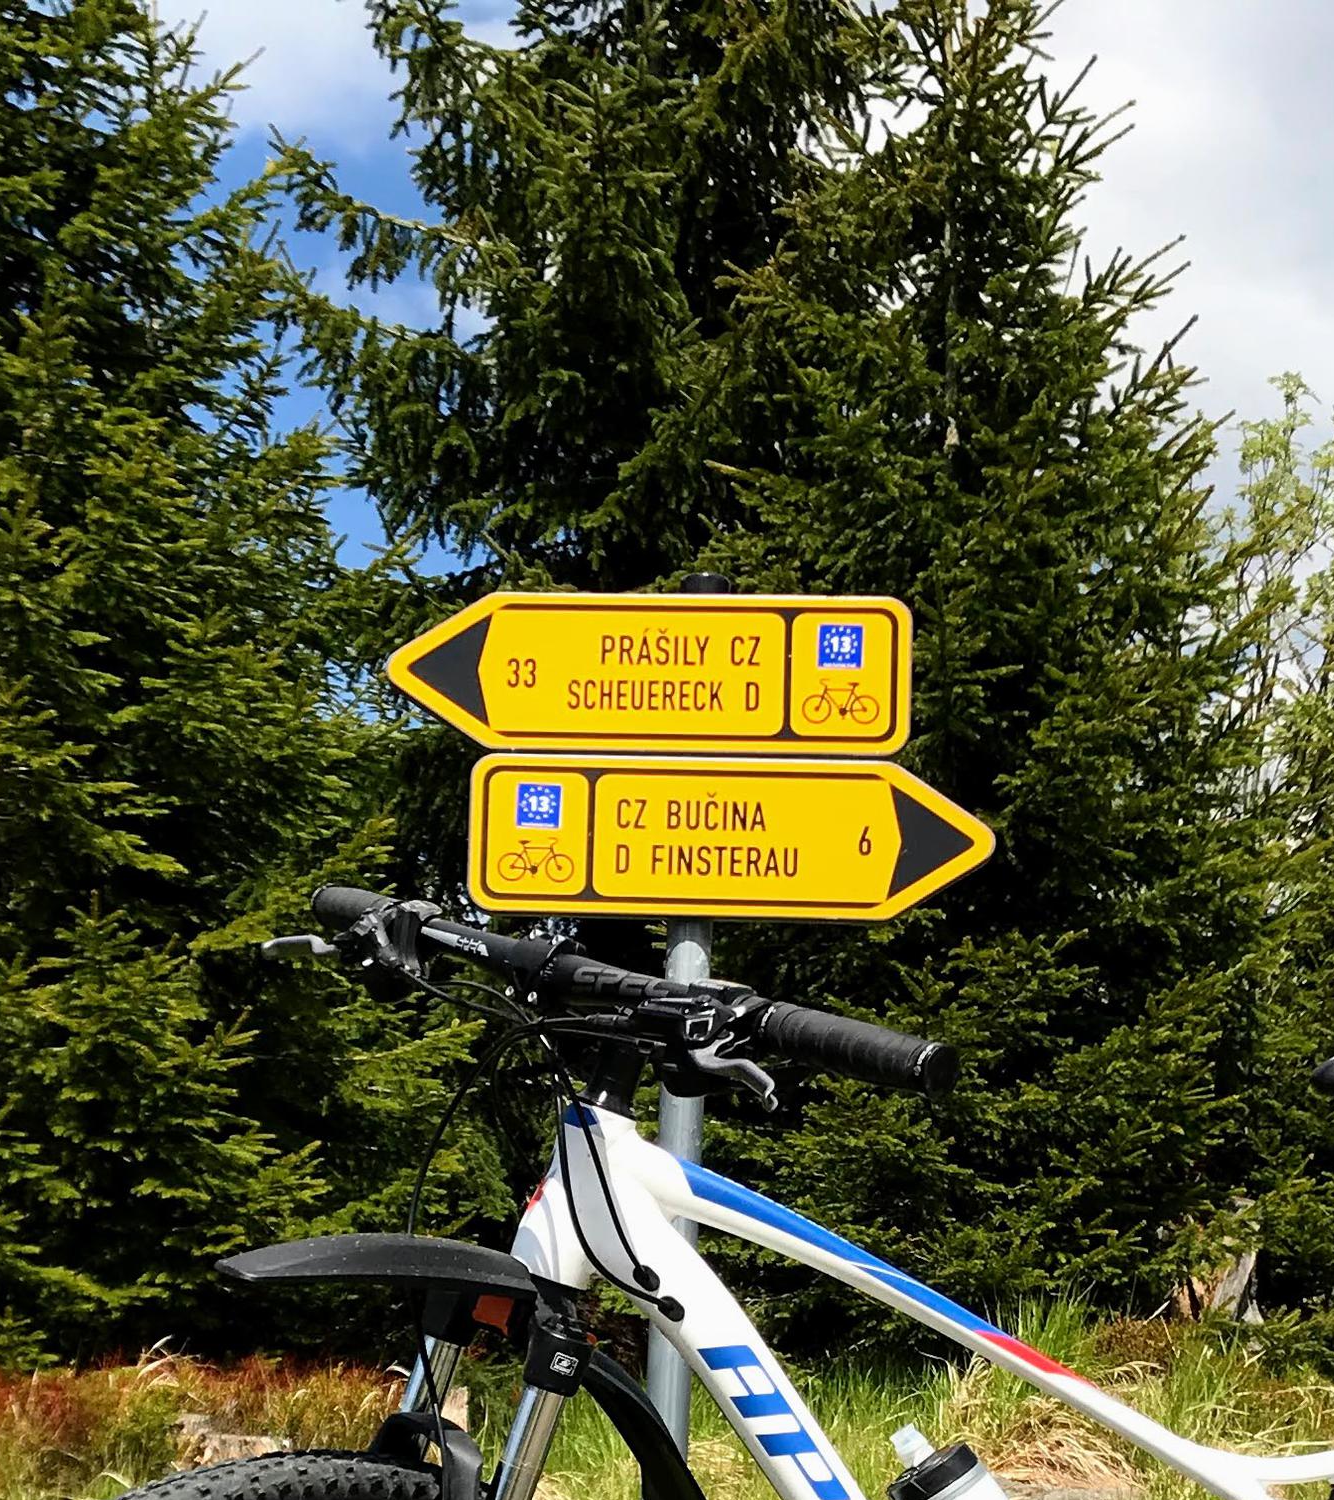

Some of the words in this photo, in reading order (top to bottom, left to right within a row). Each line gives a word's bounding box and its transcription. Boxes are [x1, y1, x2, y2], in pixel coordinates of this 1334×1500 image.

[600, 628, 710, 666] PRÁŠILY
[730, 636, 761, 666] CZ
[830, 635, 851, 653] 13
[506, 657, 537, 689] 33
[567, 679, 723, 711] SCHEUERECK
[745, 681, 760, 711] D
[528, 795, 550, 812] 13
[616, 798, 647, 829] CZ
[667, 792, 766, 831] BUČINA
[858, 826, 872, 856] 6
[615, 844, 630, 874] D
[651, 845, 798, 877] FINSTERAU
